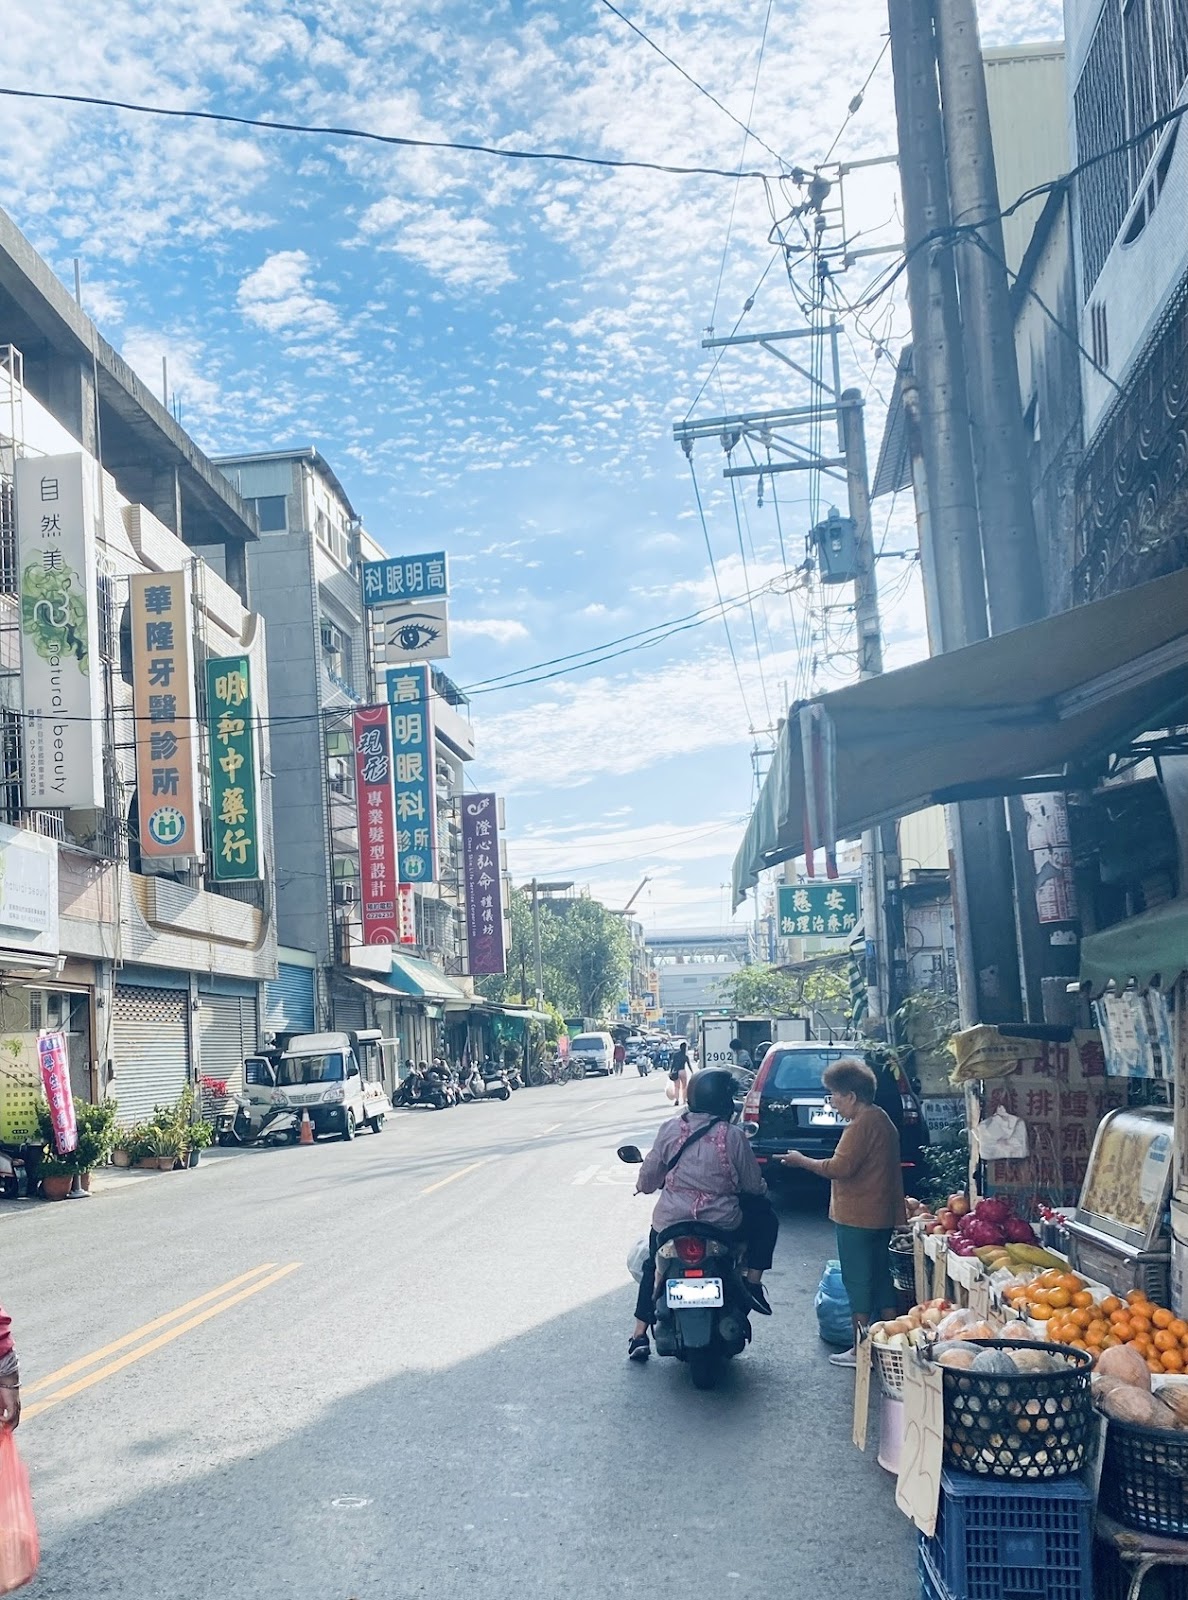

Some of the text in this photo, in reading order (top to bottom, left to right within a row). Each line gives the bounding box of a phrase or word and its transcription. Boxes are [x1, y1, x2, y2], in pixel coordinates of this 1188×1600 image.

[40, 475, 62, 573] 自然美
[50, 643, 69, 794] natural beauty
[143, 585, 180, 797] 華隆牙醫診所
[393, 674, 428, 822] 高明眼科
[214, 670, 252, 866] 明和中藥行
[366, 790, 387, 898] 專業髮型設計
[781, 912, 857, 934] 物理治療所
[706, 1051, 733, 1062] 2902
